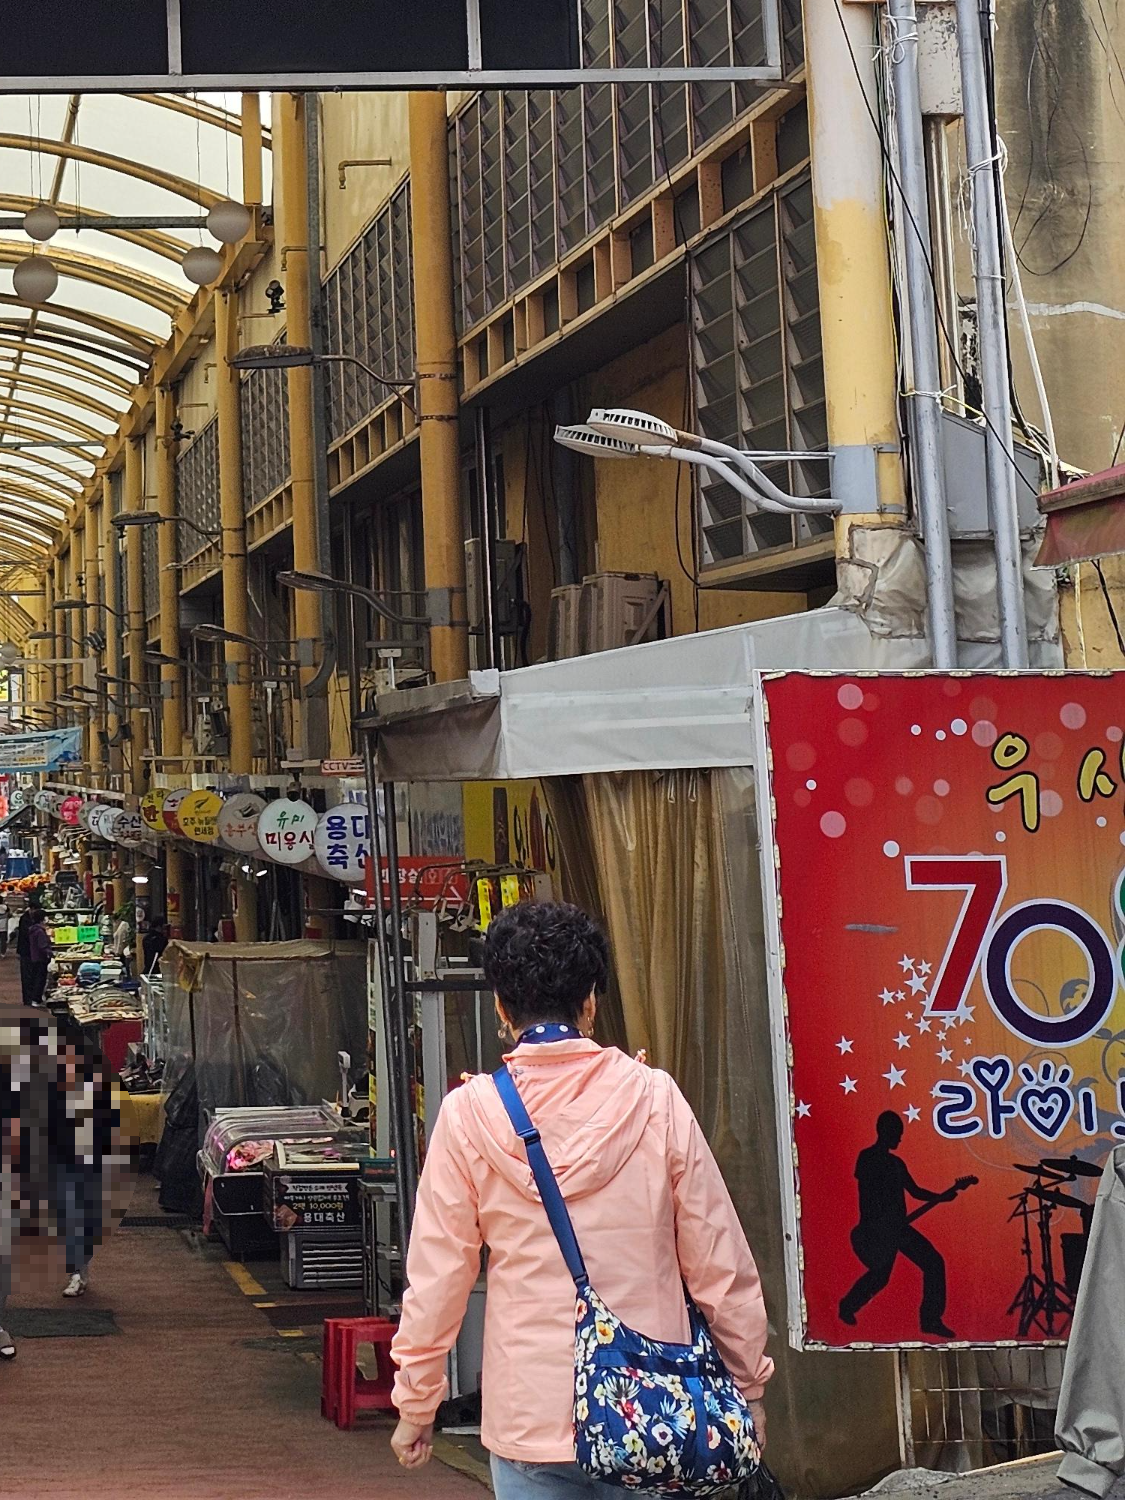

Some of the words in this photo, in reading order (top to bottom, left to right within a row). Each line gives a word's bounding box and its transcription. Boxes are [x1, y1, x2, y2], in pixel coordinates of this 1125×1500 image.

[323, 761, 349, 770] CCTV
[117, 815, 142, 829] 수산
[264, 829, 315, 851] 미용실
[303, 1211, 346, 1223] 용대축산
